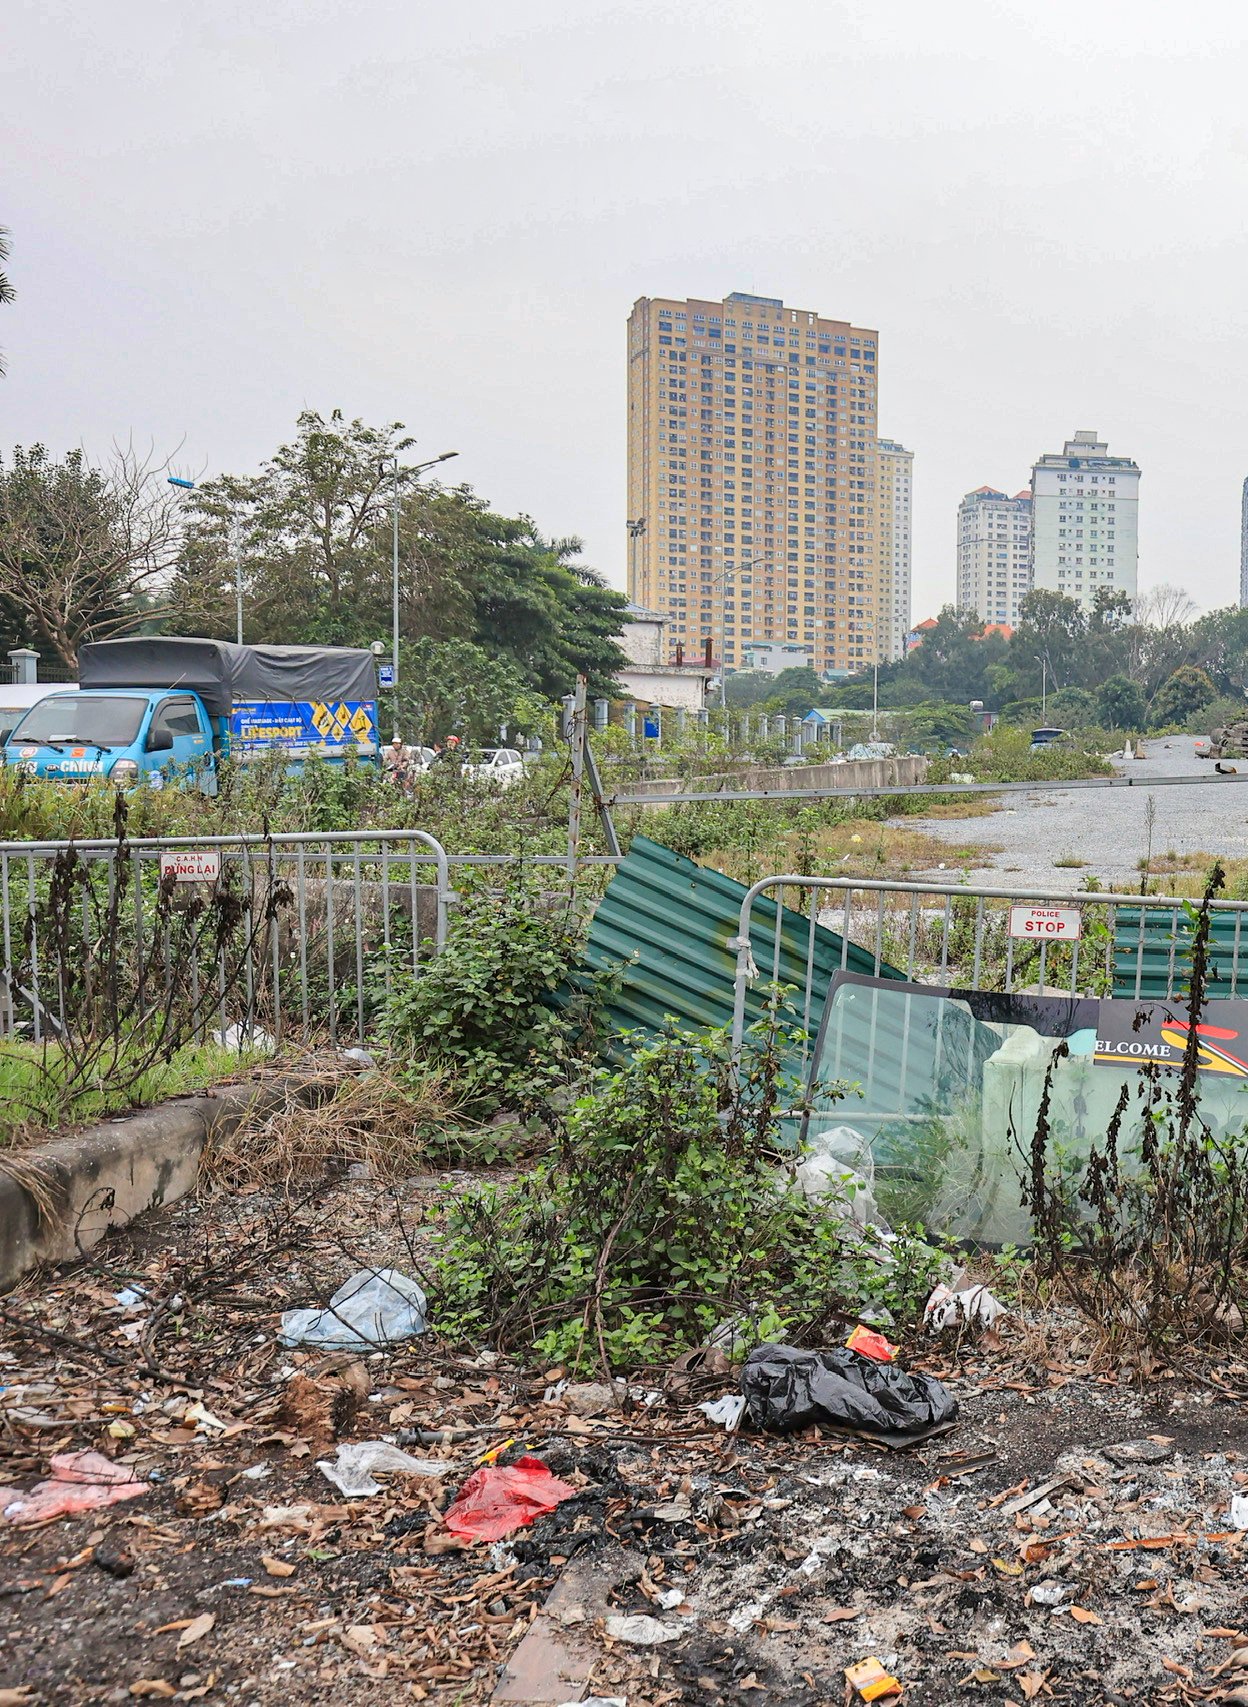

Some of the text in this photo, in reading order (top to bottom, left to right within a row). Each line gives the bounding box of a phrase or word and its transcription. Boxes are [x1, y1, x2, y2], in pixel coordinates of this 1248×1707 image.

[197, 865, 215, 876] LẠI
[1031, 910, 1060, 918] POLICE
[1025, 921, 1065, 933] STOP
[1095, 1040, 1171, 1057] ELCOME
